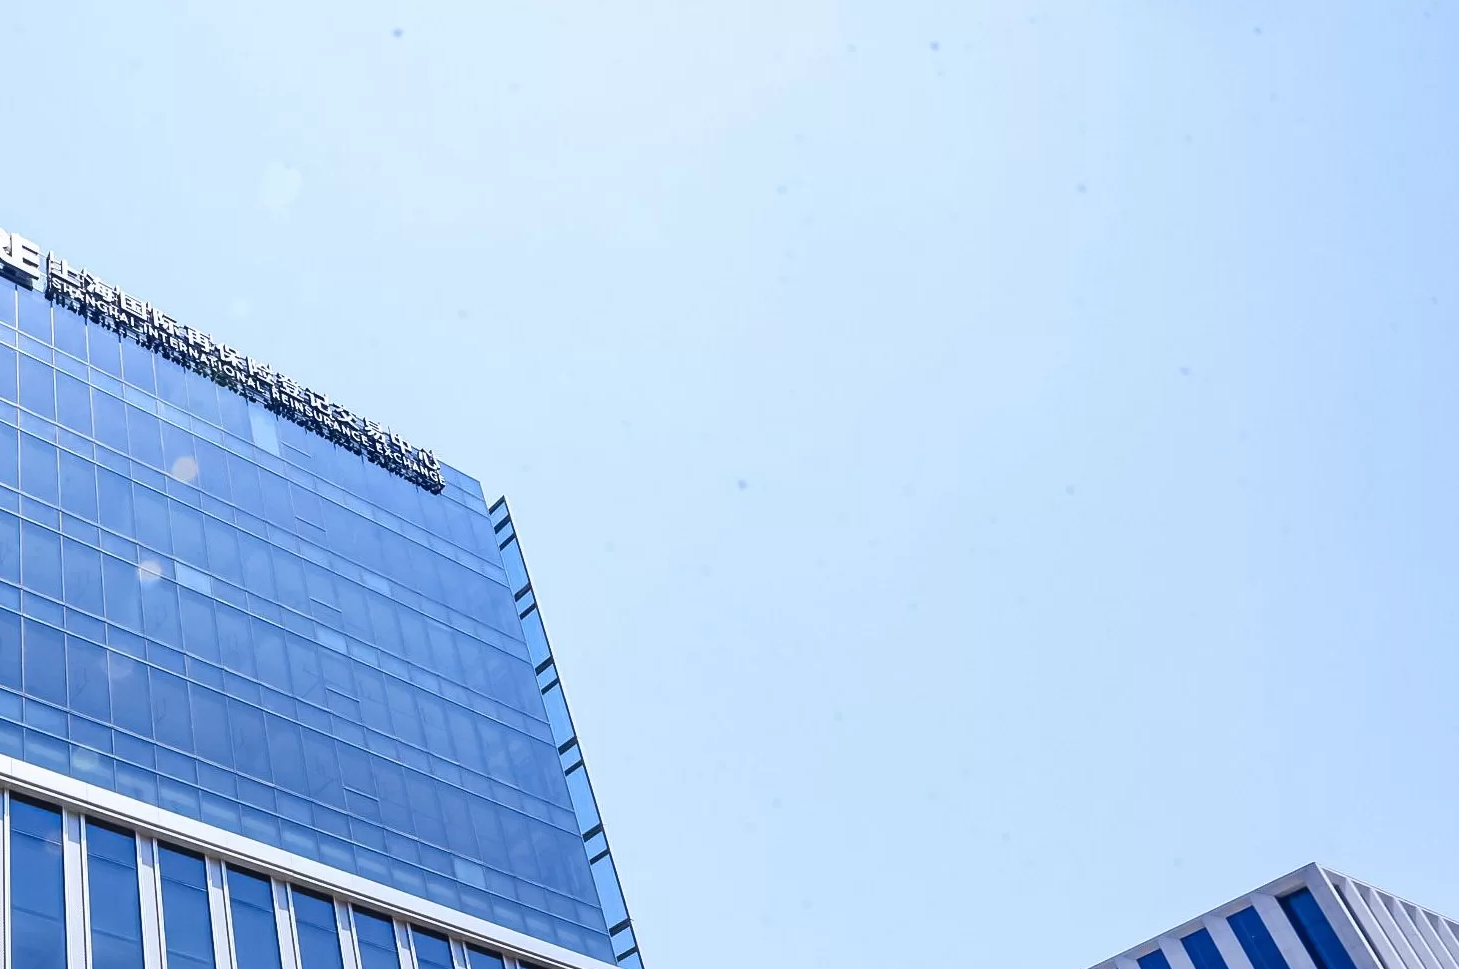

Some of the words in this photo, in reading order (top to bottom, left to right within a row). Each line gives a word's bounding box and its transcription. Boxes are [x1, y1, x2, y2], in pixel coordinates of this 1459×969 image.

[51, 277, 136, 328] SHANGHAI
[142, 323, 264, 393] INTERNATIONAL
[271, 389, 368, 446] REINSURANCE
[375, 442, 445, 485] EXCHANGE
